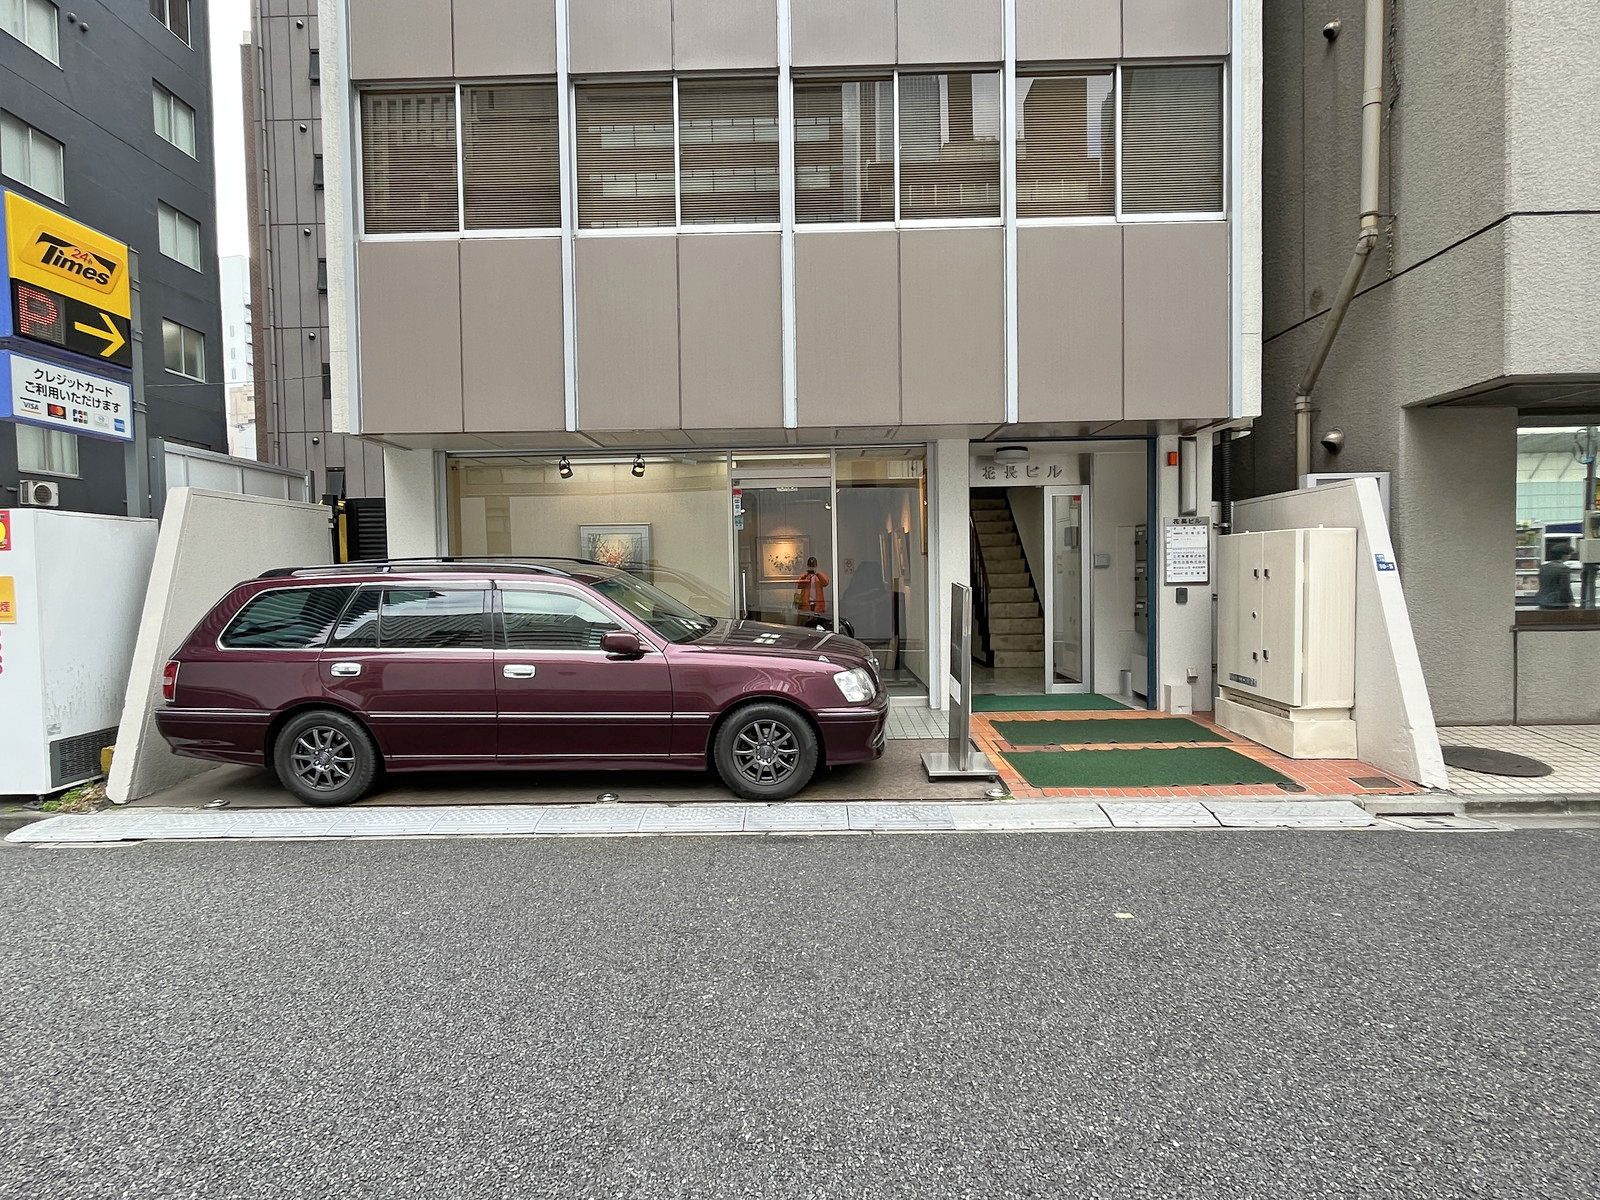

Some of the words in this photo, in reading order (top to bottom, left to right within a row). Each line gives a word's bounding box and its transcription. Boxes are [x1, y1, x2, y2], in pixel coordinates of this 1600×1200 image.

[35, 232, 117, 286] Times
[18, 285, 58, 334] P
[25, 380, 121, 413] ご利用いただけます
[33, 368, 113, 398] クレジットカード
[23, 401, 40, 411] VISA
[982, 464, 1063, 480] 花長ビル
